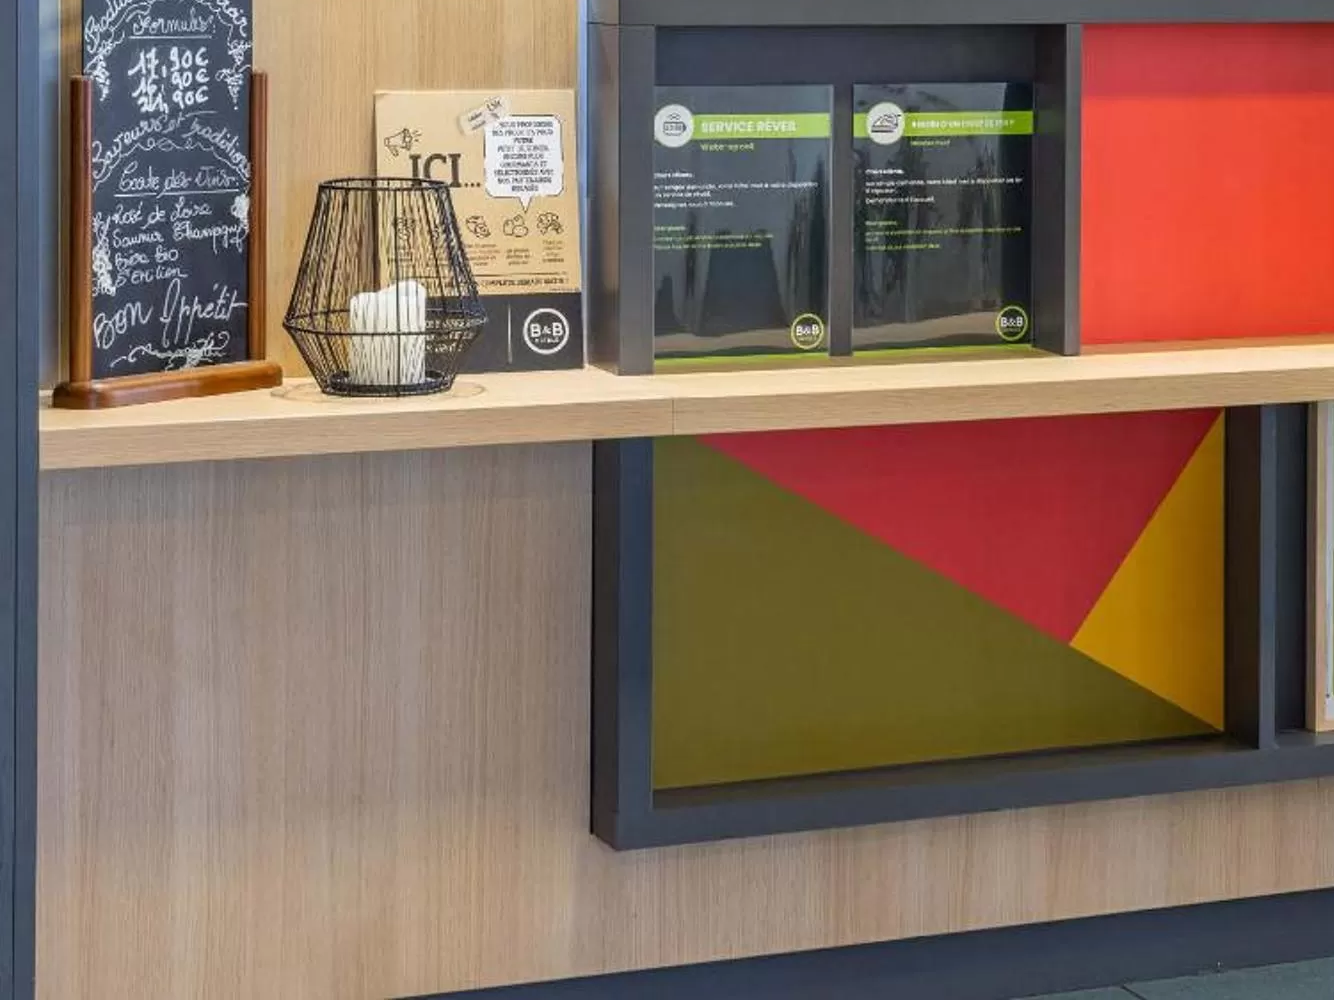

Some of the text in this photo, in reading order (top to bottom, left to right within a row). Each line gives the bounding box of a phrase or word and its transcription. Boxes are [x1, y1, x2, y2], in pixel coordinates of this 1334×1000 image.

[702, 120, 753, 133] SERVICE
[1001, 316, 1023, 327] B&B
[530, 322, 563, 338] B&B
[796, 325, 819, 336] B&B
